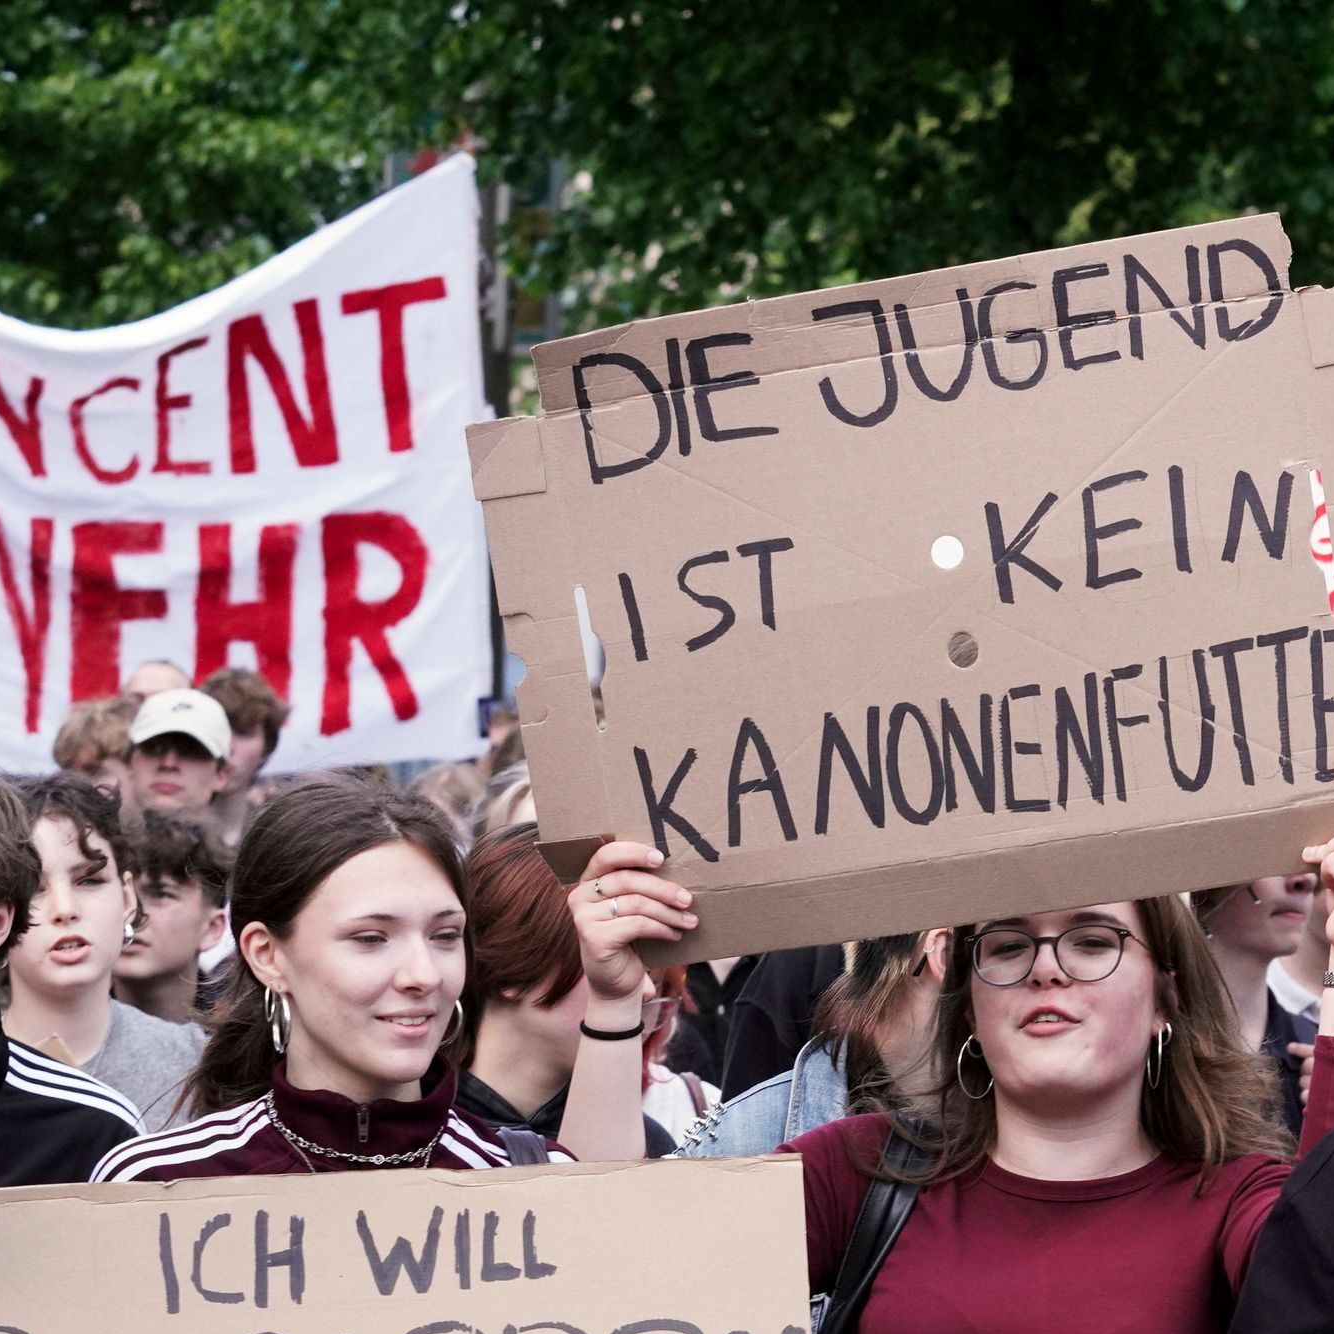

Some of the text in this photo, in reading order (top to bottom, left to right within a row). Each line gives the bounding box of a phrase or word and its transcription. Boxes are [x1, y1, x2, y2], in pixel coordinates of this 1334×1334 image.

[68, 276, 448, 486] CENT
[572, 237, 1285, 485] DIE JUGEND
[617, 465, 1295, 662] IST KEIN
[159, 1205, 558, 1315] ICH WILL
